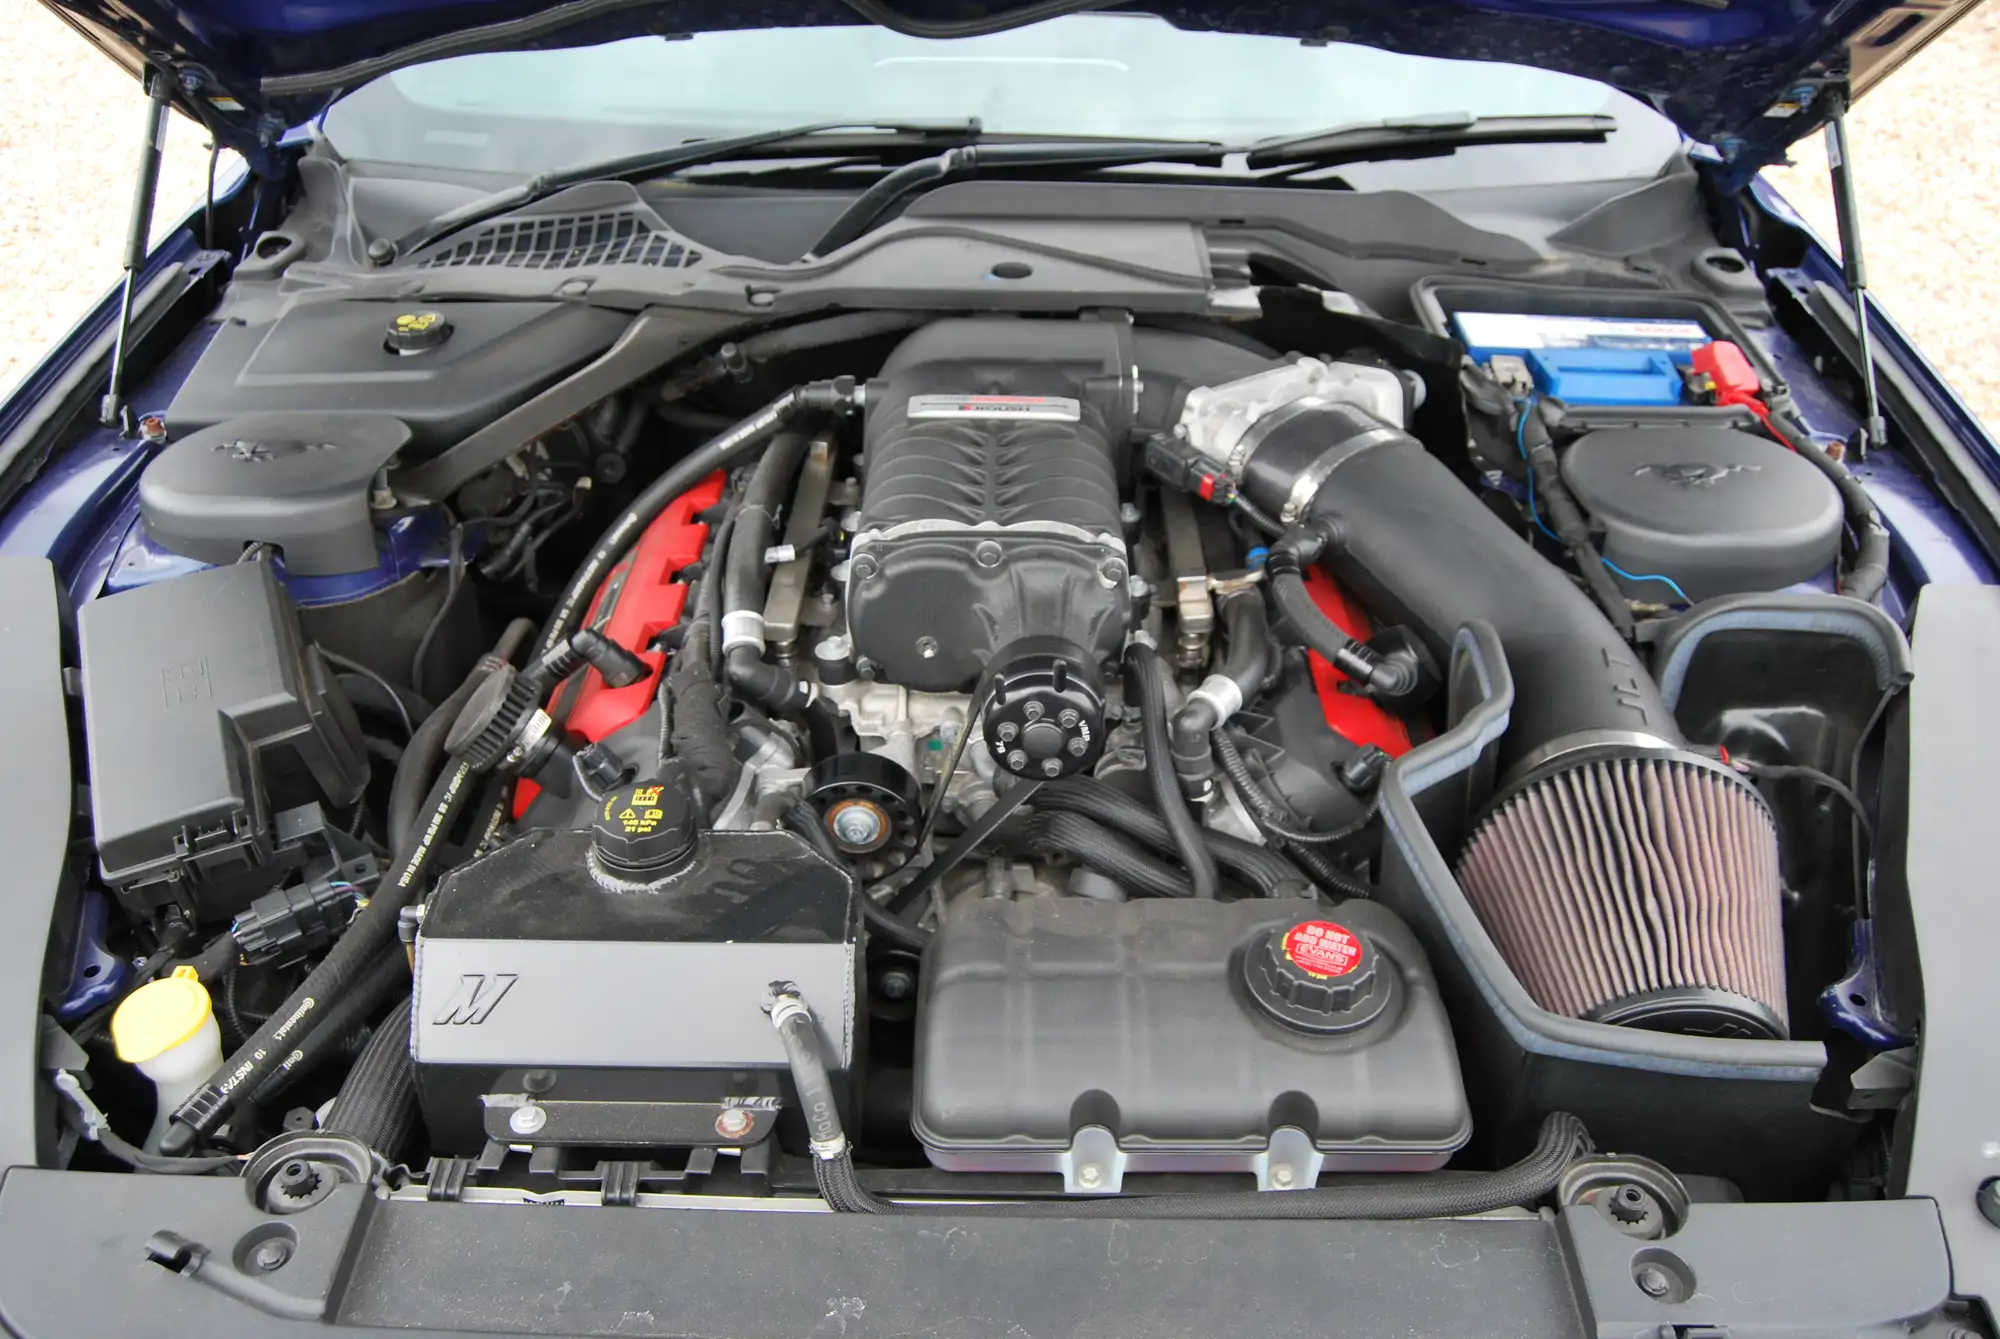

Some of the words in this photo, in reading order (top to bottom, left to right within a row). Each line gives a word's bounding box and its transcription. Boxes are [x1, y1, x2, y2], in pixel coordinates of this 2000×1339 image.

[1078, 719, 1091, 742] VMP
[411, 845, 427, 867] MADE
[406, 863, 417, 875] IN
[397, 871, 412, 888] USA
[254, 1048, 267, 1060] 10
